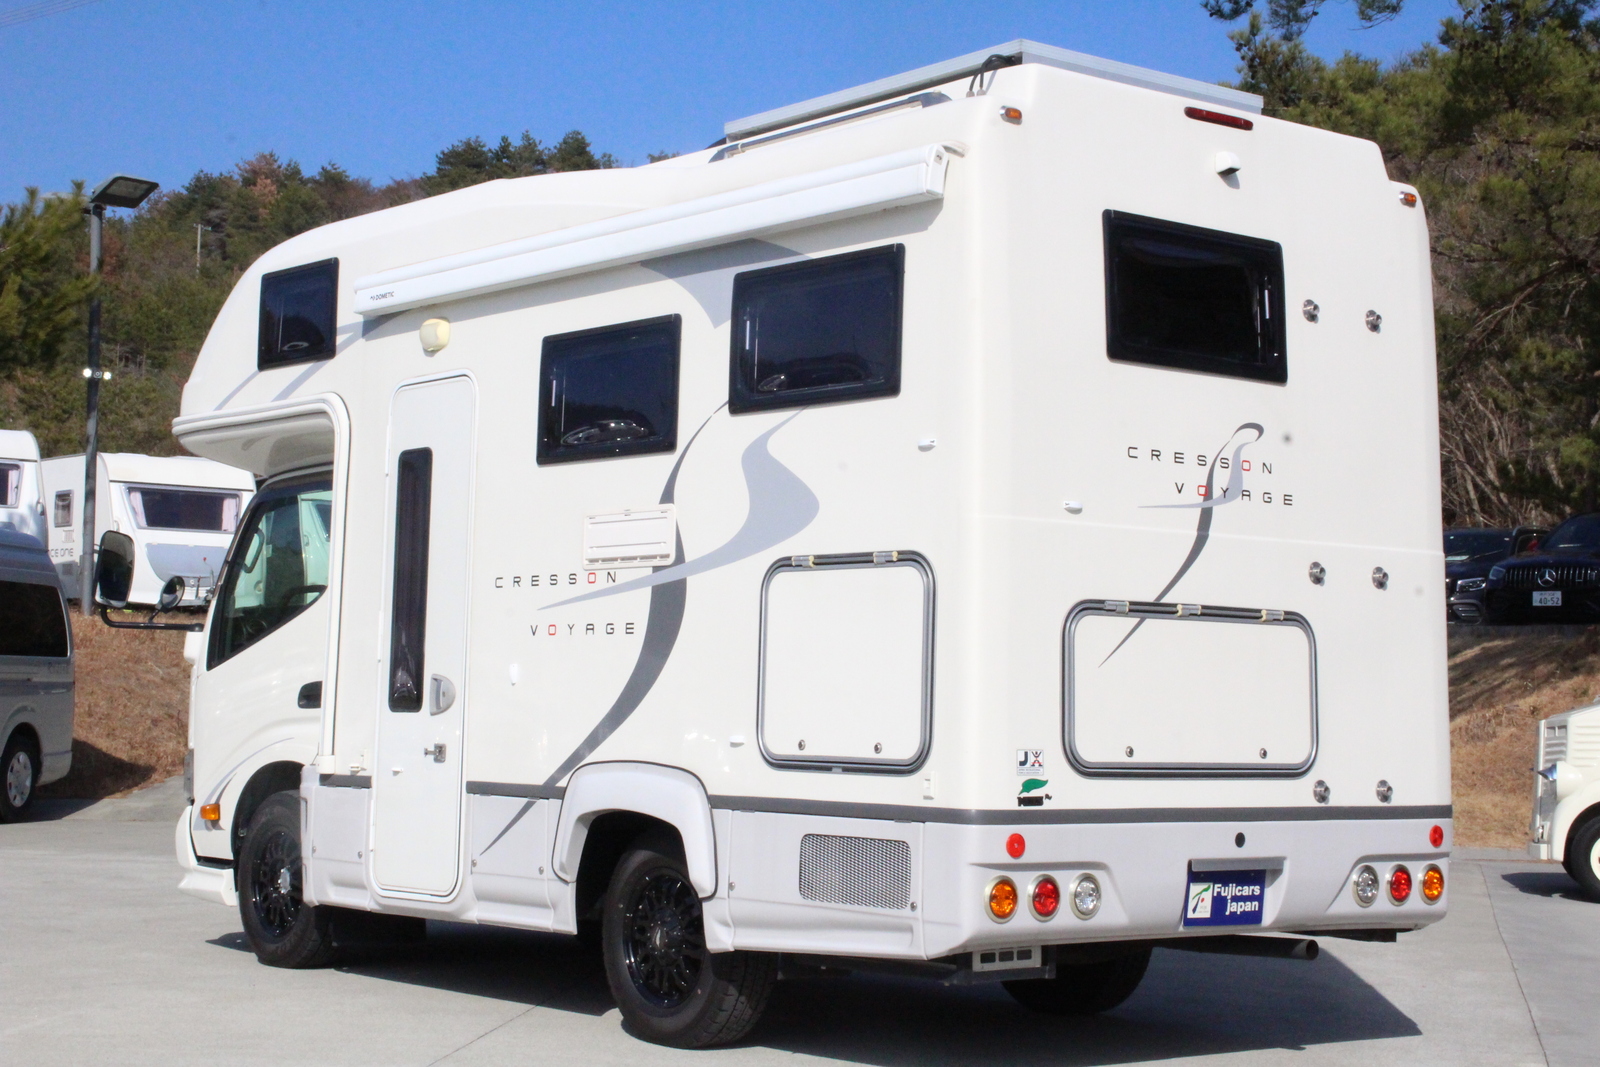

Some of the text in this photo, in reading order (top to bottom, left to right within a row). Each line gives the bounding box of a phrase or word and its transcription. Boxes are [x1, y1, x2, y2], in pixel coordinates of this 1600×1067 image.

[375, 291, 395, 301] DOMETIC
[1127, 446, 1273, 474] CRESSON
[1174, 482, 1293, 506] VOYAGE
[494, 571, 617, 589] CRESSON
[1538, 597, 1560, 605] 40-52
[530, 622, 635, 637] VOYAGE
[1213, 883, 1261, 899] Fujicars
[1225, 899, 1259, 915] japan
